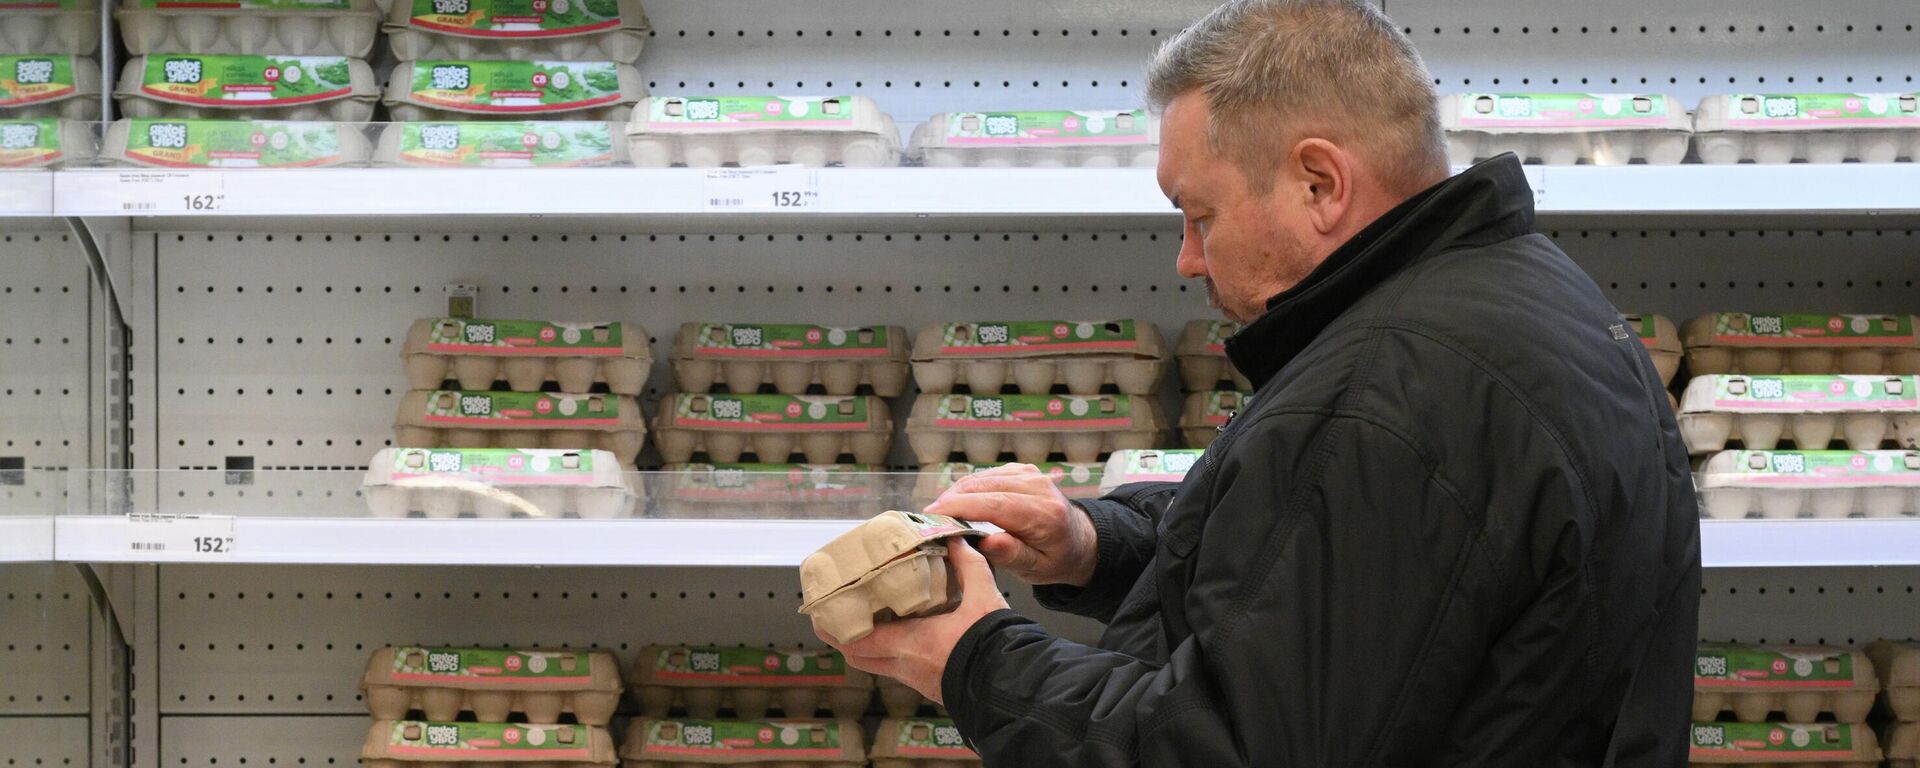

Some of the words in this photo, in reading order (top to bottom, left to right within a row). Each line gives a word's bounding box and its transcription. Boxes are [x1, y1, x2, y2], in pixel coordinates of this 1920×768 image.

[184, 195, 214, 210] 162
[772, 192, 802, 207] 152
[194, 537, 224, 552] 152
[936, 727, 958, 736] ЯРКО
